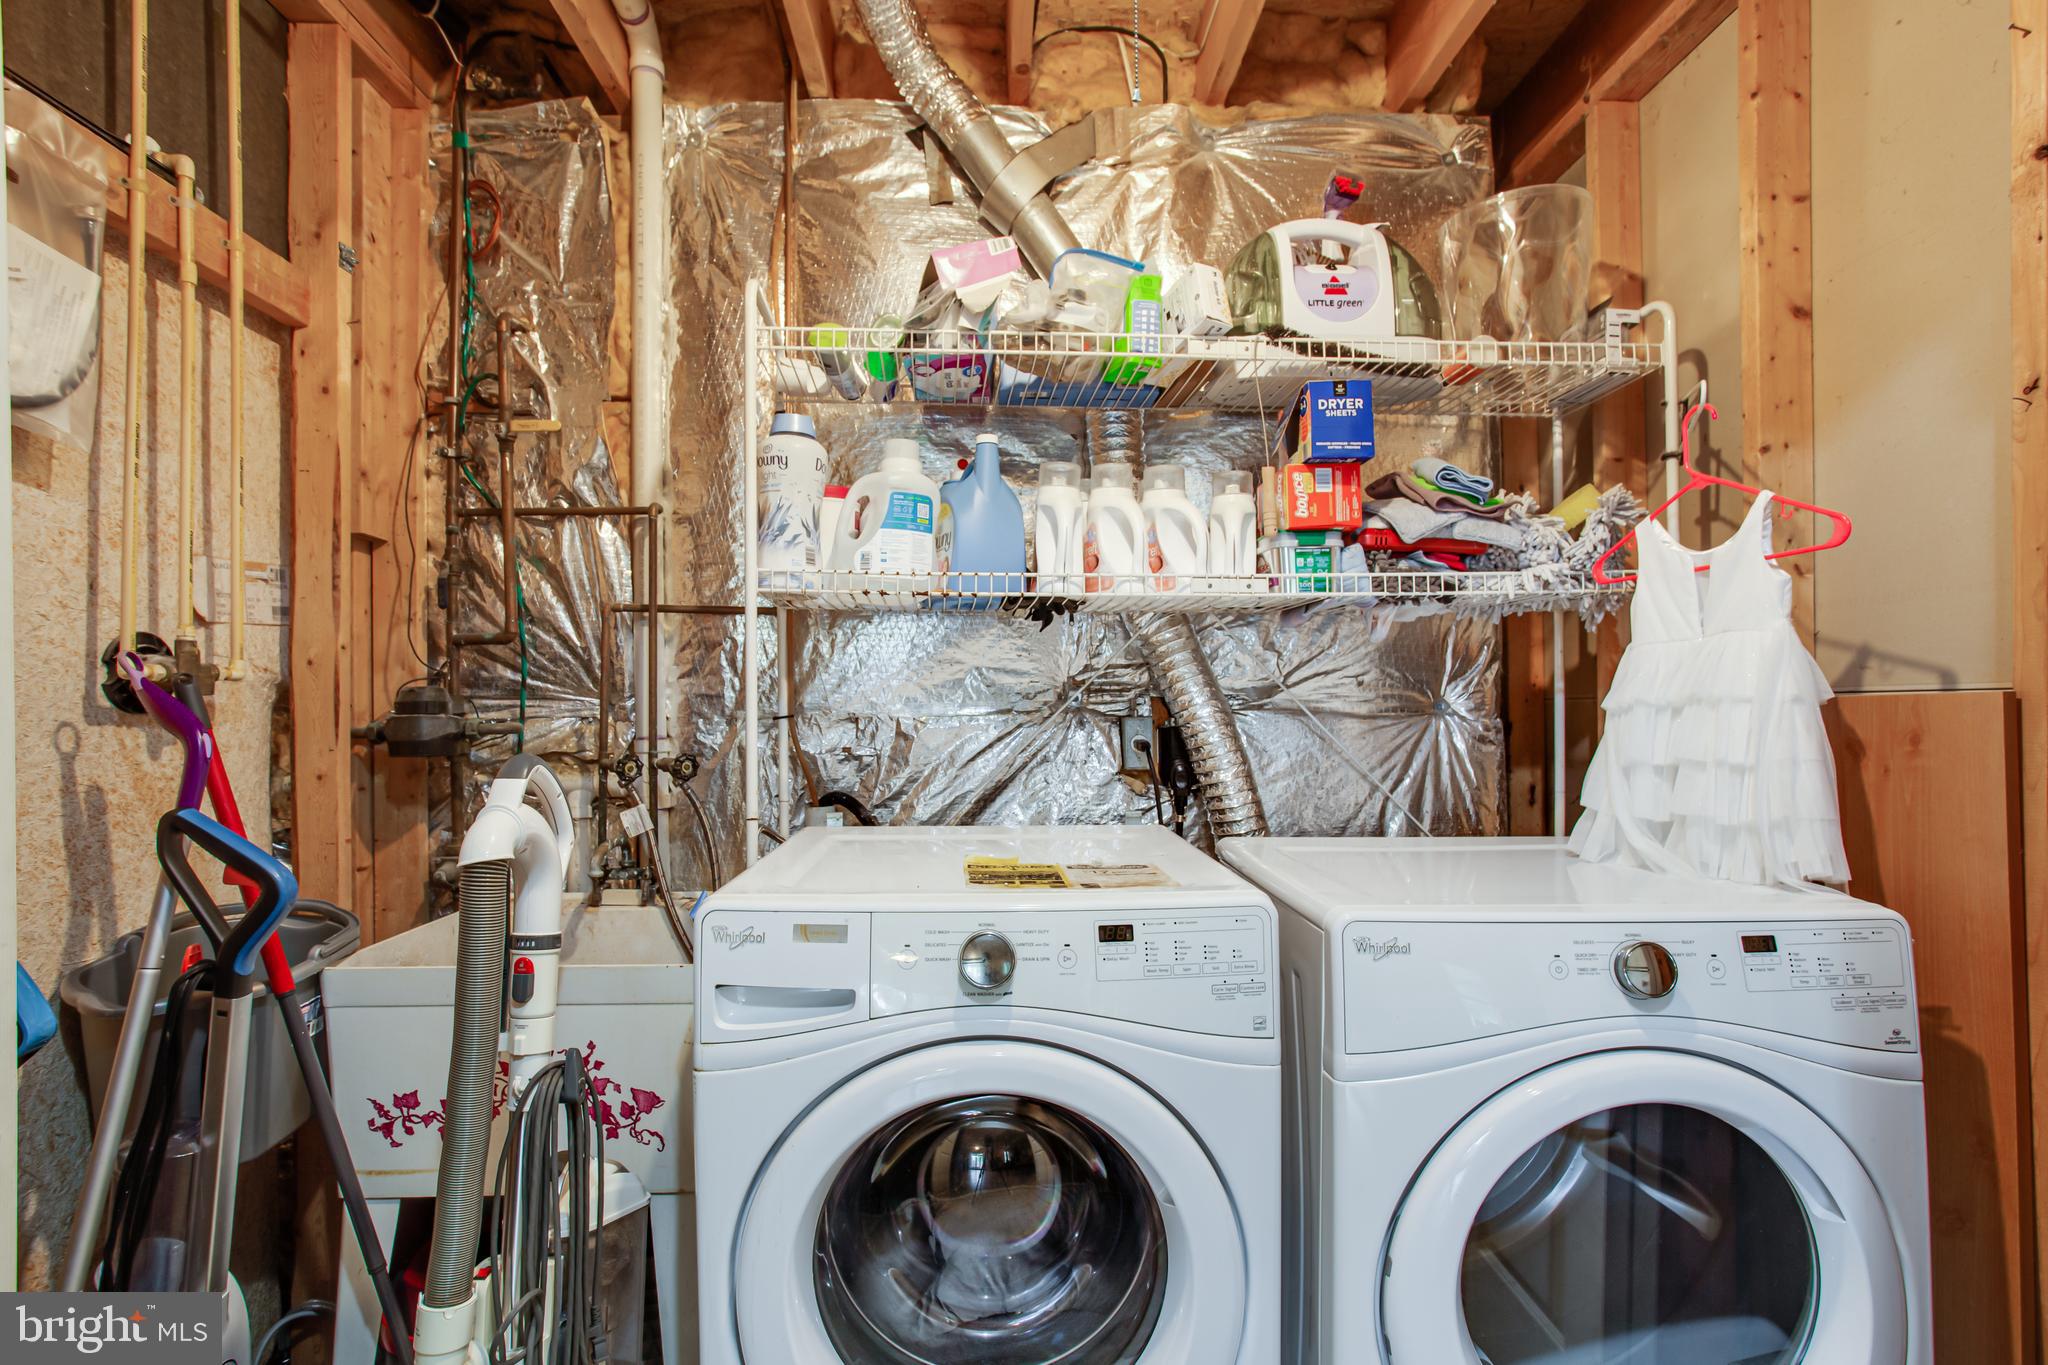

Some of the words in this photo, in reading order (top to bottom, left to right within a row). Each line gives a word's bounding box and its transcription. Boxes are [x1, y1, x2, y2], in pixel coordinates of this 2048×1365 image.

[1308, 299, 1335, 307] LITTLE
[1336, 299, 1363, 309] green
[1317, 398, 1364, 410] DRYER
[1325, 409, 1357, 417] SHEETS
[757, 454, 788, 470] owny
[1292, 472, 1310, 518] bounce
[711, 927, 766, 946] Whirlpool
[1353, 938, 1411, 957] Whirlpool
